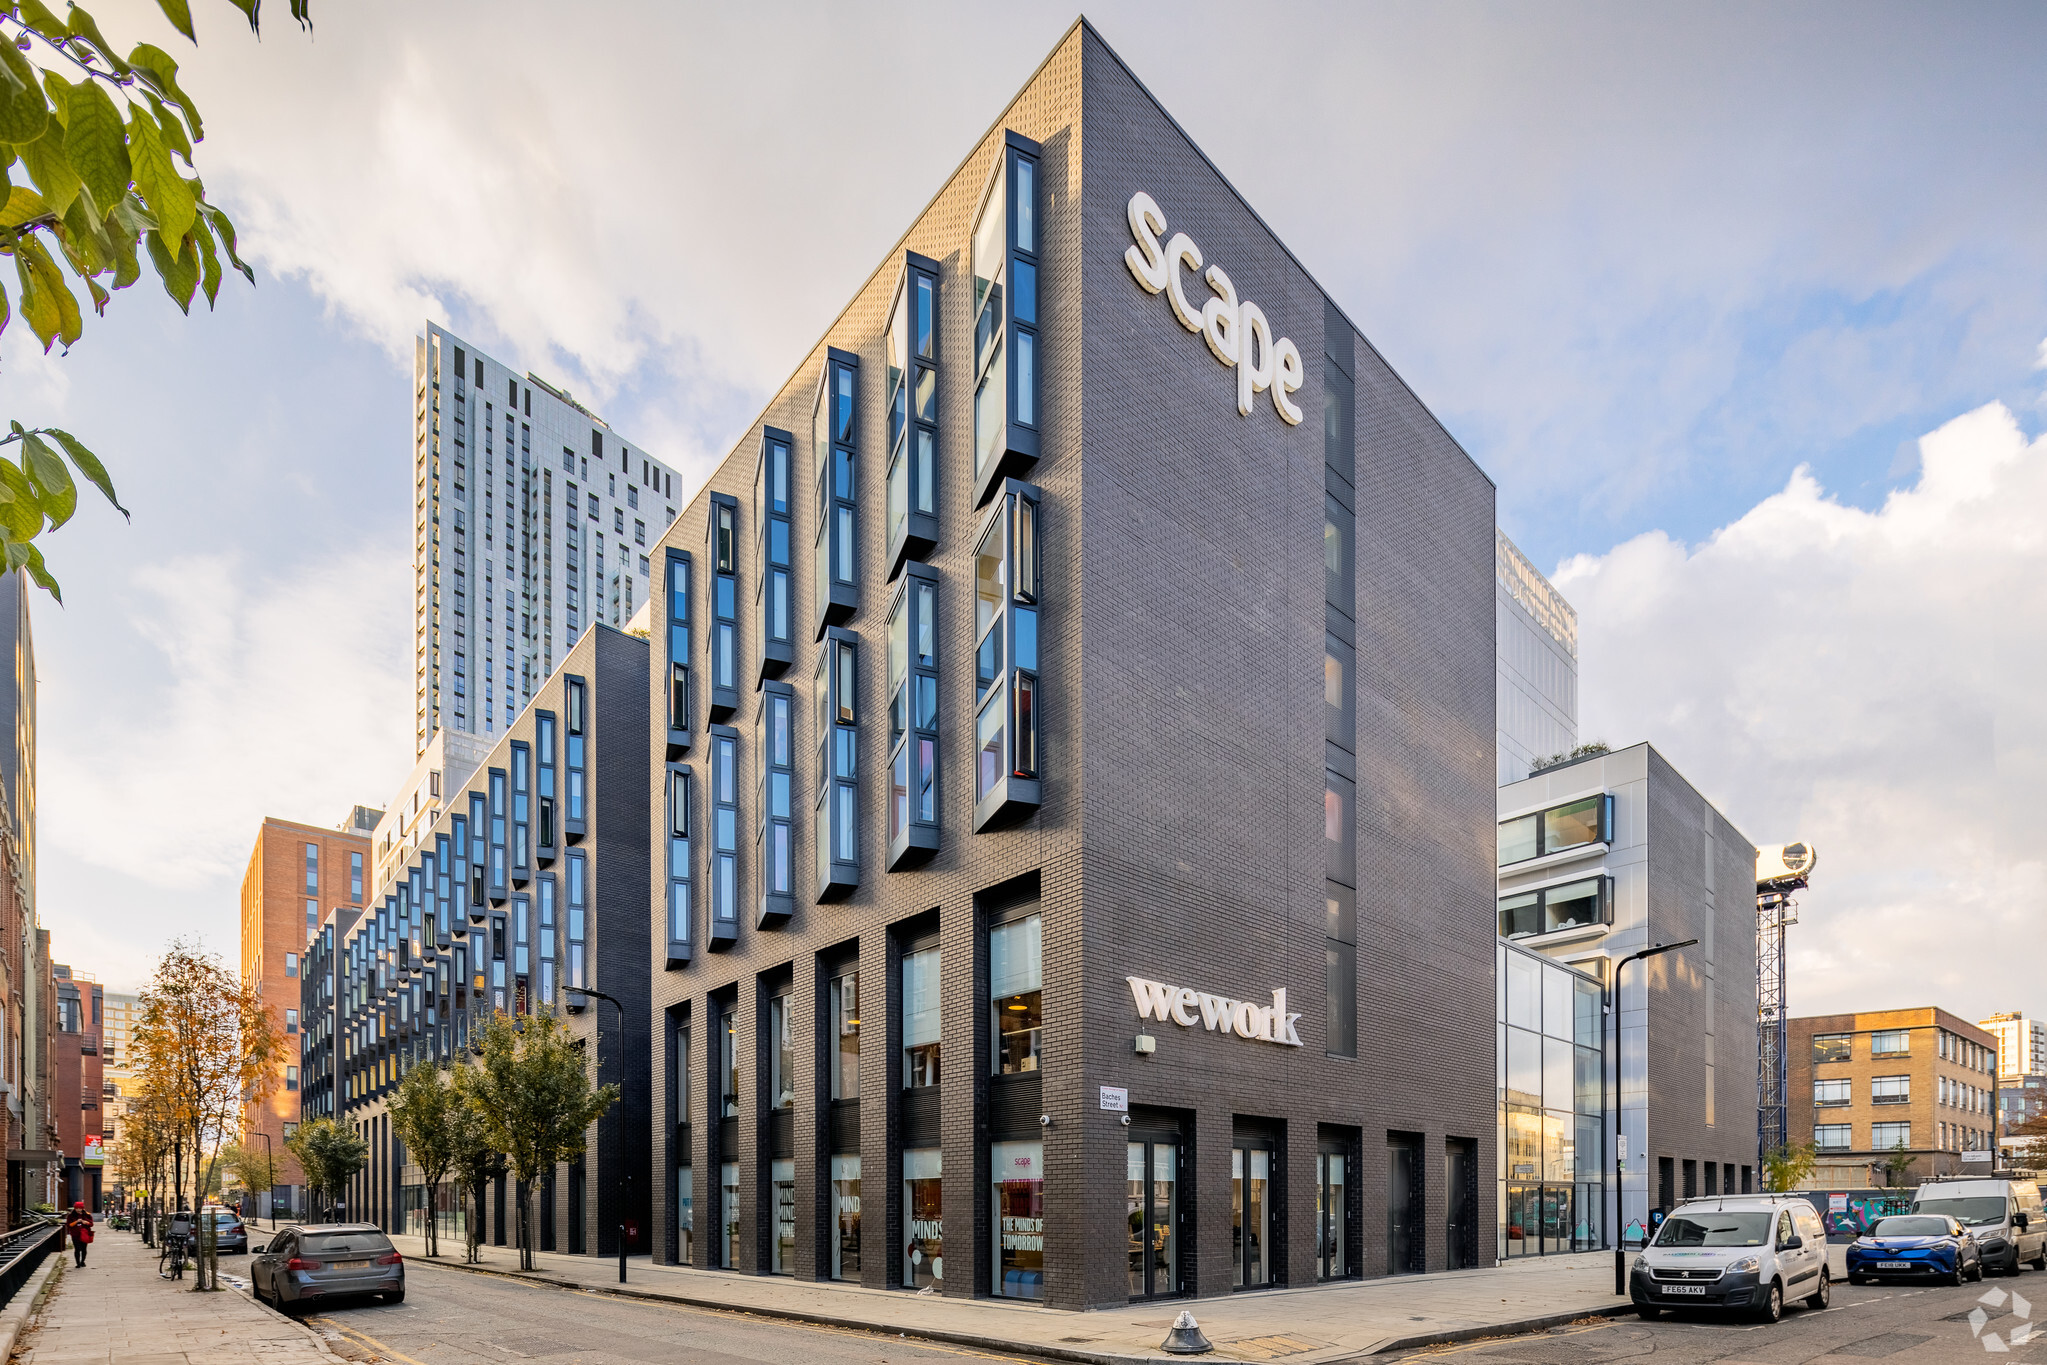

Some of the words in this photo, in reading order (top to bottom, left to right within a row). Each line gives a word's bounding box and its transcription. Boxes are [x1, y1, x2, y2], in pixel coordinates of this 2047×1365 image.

[1124, 190, 1304, 426] scape
[1125, 976, 1304, 1047] wework
[1102, 1092, 1121, 1101] Baches
[1102, 1100, 1118, 1108] Street
[1014, 1157, 1031, 1168] scape
[1002, 1218, 1014, 1231] THE
[1014, 1218, 1035, 1232] MINDS
[1035, 1218, 1043, 1233] OF
[1002, 1234, 1043, 1251] TOMORROW
[1667, 1285, 1687, 1294] FE65
[1688, 1286, 1704, 1294] AKV
